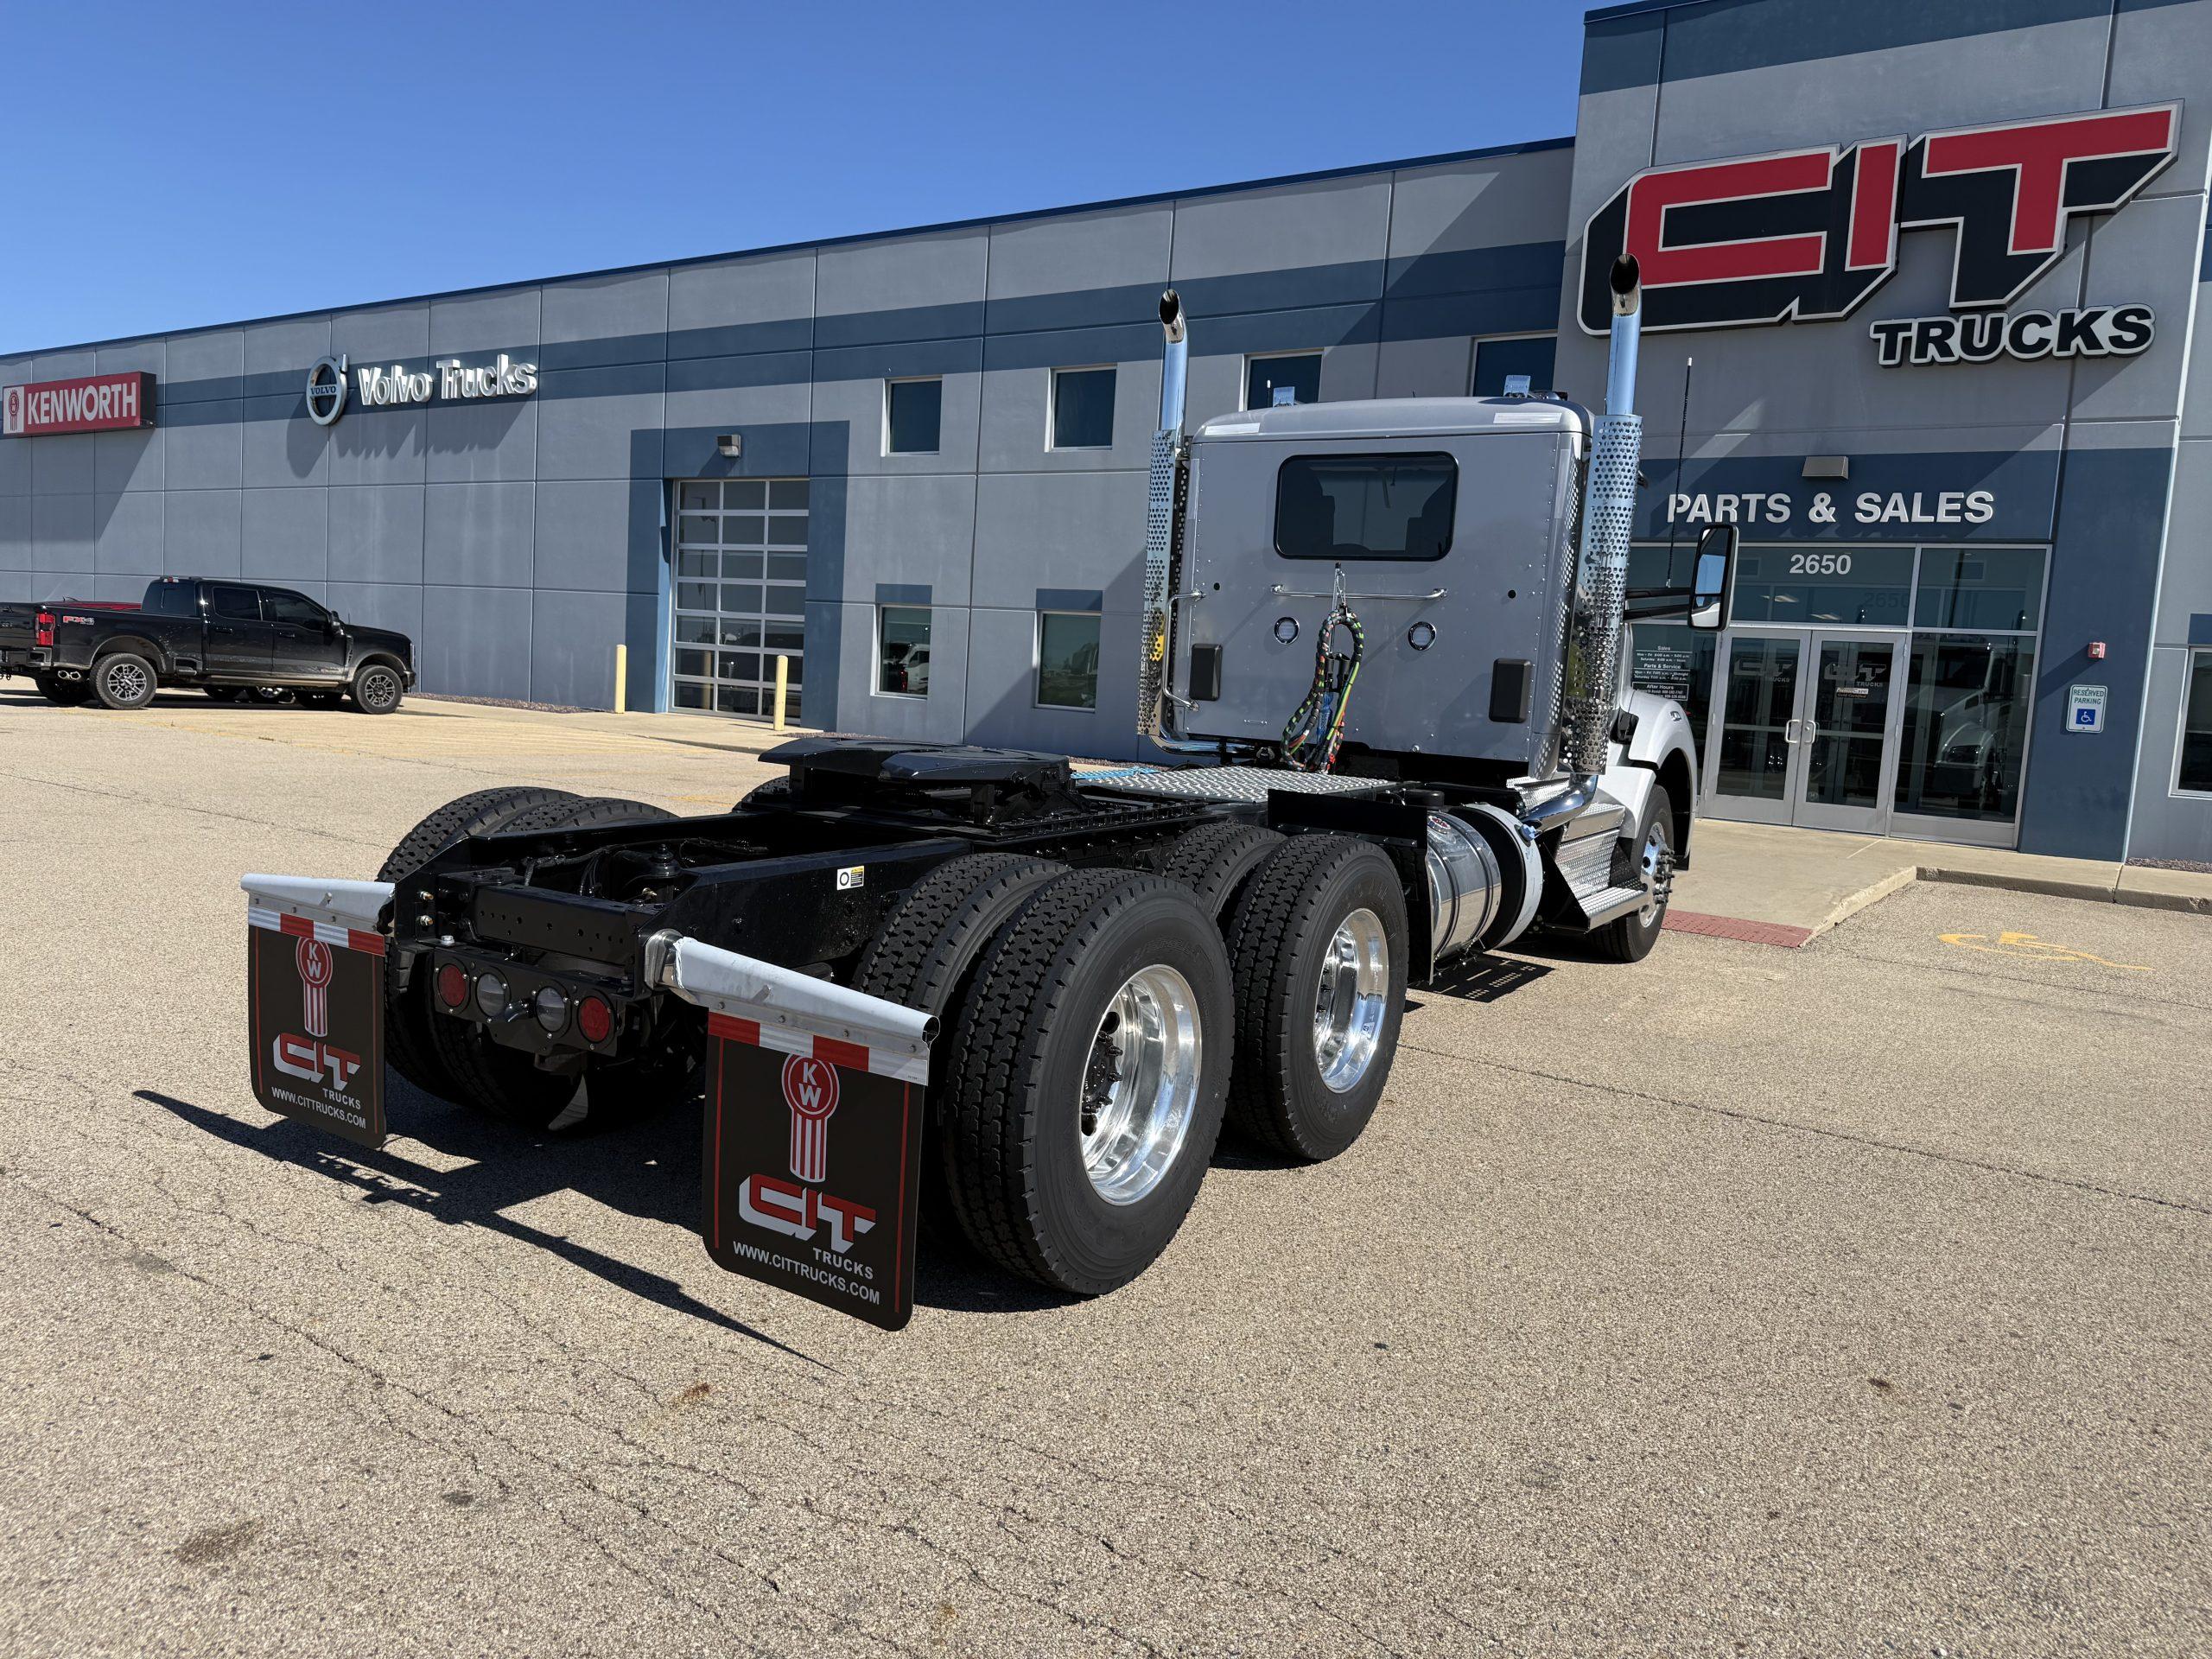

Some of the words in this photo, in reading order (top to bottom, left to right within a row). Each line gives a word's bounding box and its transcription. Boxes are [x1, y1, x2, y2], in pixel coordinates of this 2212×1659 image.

[1578, 99, 2184, 338] CIT
[1872, 306, 2154, 365] TRUCKS
[310, 386, 337, 396] VOLVO
[358, 365, 434, 406] Volvo
[436, 354, 537, 400] Trucks
[28, 382, 137, 425] KENWORTH
[1667, 493, 1791, 524] PARTS
[1808, 493, 1836, 524] &
[1854, 491, 1994, 524] SALES
[1789, 554, 1852, 575] 2650
[272, 1033, 360, 1091] CIT
[271, 1086, 366, 1129] WWW.CITTRUCKS.COM
[322, 1088, 361, 1109] TRUCKS
[739, 1173, 876, 1254] CIT
[733, 1241, 880, 1306] WWW.CITTRUCKS.COM
[812, 1247, 874, 1280] TRUCKS
